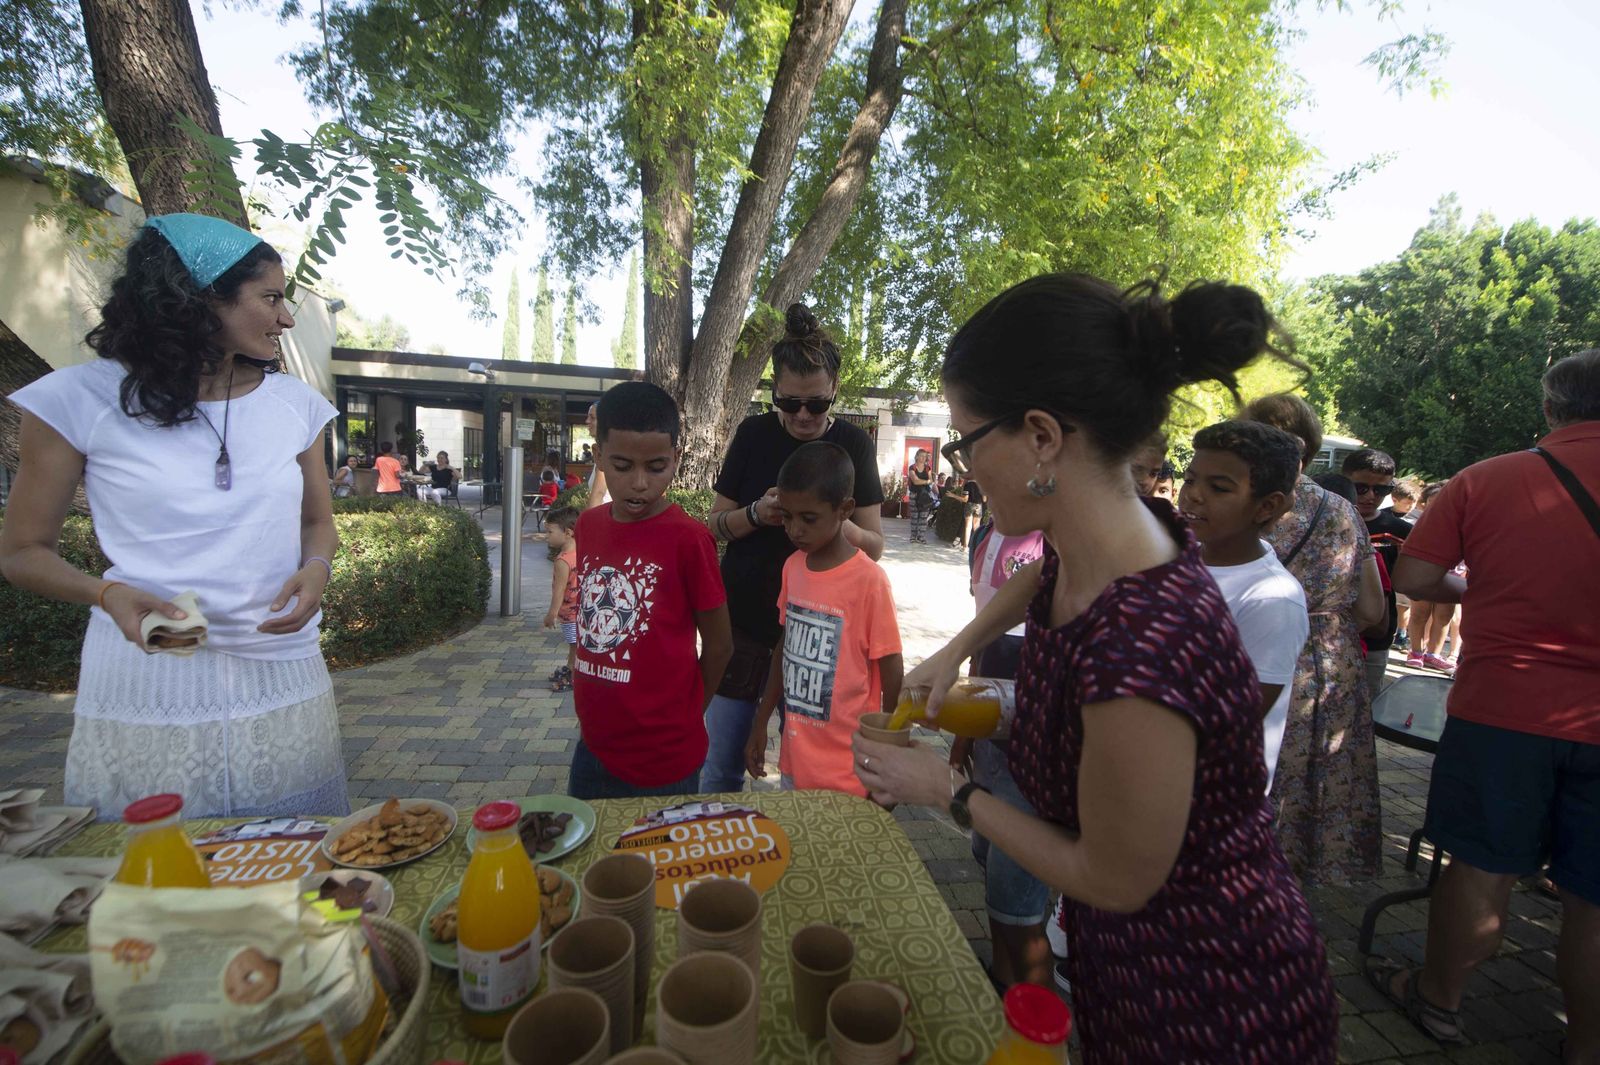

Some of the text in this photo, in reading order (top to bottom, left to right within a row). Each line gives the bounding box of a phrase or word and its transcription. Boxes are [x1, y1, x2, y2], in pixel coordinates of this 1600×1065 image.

[597, 665, 631, 683] LEGEND
[669, 814, 757, 842] Justo
[637, 834, 775, 864] Comerci
[656, 845, 782, 880] productos
[209, 861, 315, 882] Come
